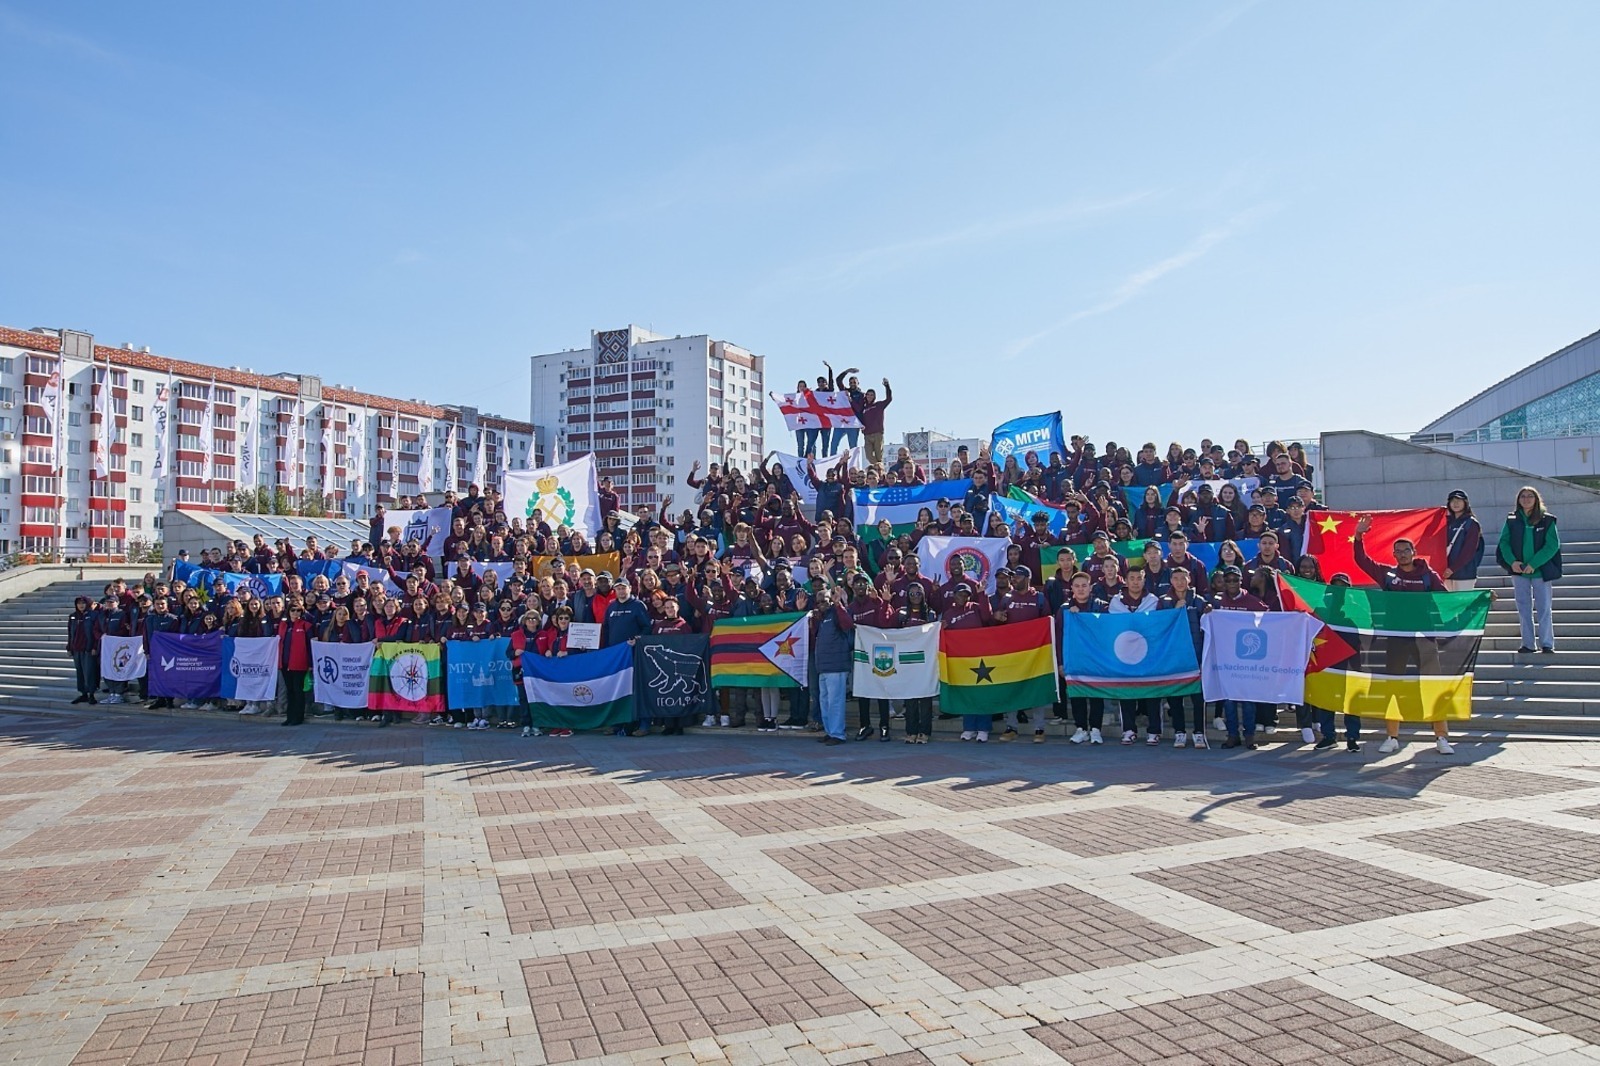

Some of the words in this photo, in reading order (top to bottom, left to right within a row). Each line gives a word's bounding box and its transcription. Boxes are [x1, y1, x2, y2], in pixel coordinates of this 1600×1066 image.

[1015, 427, 1050, 446] МГРИ
[449, 662, 475, 674] МГУ
[488, 660, 513, 671] 270
